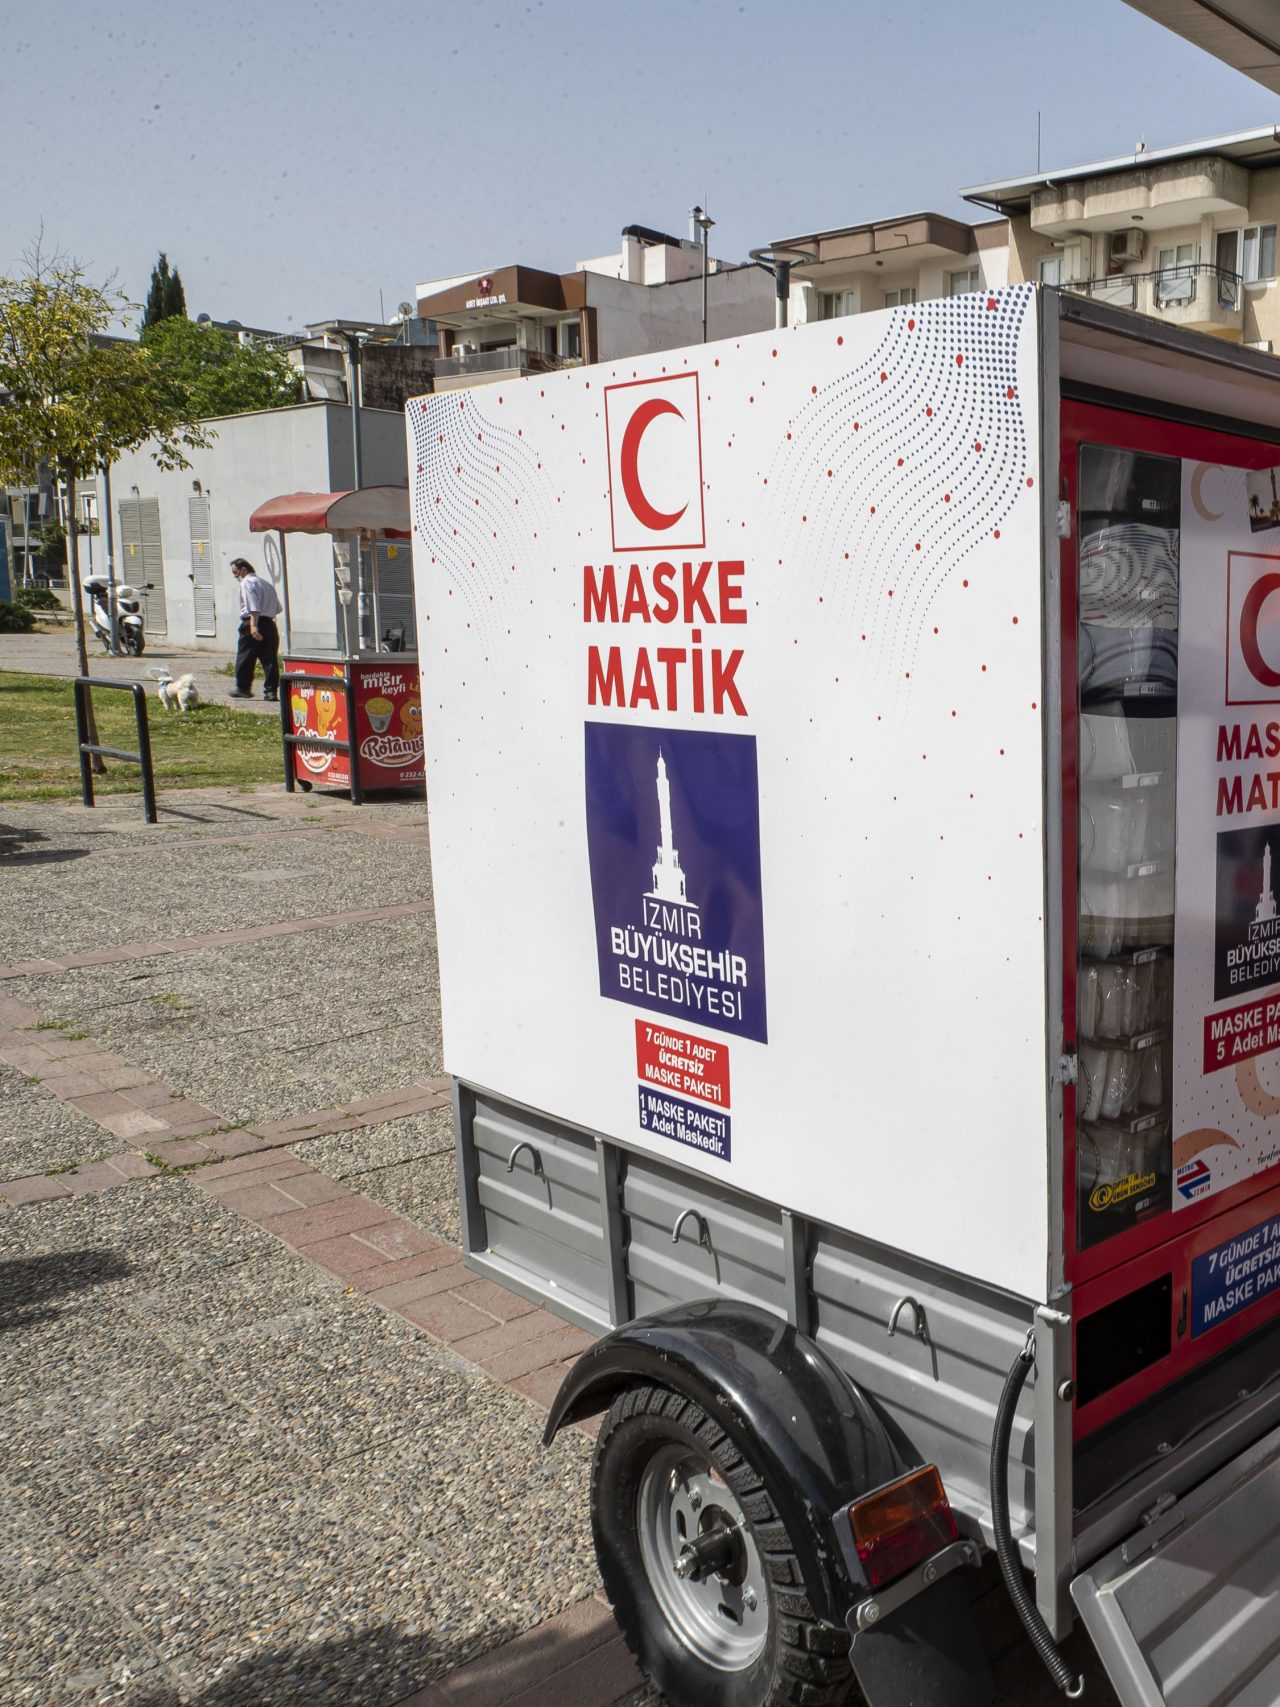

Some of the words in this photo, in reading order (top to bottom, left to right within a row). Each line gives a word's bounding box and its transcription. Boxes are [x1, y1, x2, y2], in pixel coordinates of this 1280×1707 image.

[583, 560, 747, 624] MASKE
[381, 683, 406, 695] keyfi
[588, 629, 748, 716] MATİK
[643, 898, 702, 940] İZMİR
[611, 924, 747, 987] BÜYÜKŞEHİR
[1211, 1007, 1262, 1040] MASKE
[645, 1028, 652, 1042] 7
[654, 1031, 683, 1052] GÜNDE
[685, 1040, 691, 1054] 1
[693, 1046, 716, 1062] ADET
[659, 1049, 704, 1077] ÜCRETSİZ
[1217, 1043, 1225, 1060] 5
[1232, 1032, 1264, 1056] Adet
[645, 1064, 681, 1088] MASKE
[684, 1076, 721, 1102] PAKETİ
[640, 1094, 645, 1108] 1
[648, 1096, 684, 1123] MASKE
[687, 1110, 726, 1137] PAKETİ
[641, 1111, 647, 1125] 5
[652, 1115, 675, 1137] Adet
[677, 1123, 724, 1155] Maskedir.
[1177, 1163, 1194, 1175] METRO
[1209, 1253, 1217, 1274] 7
[1219, 1232, 1259, 1264] GÜNDE
[1262, 1226, 1269, 1244] 1
[1204, 1279, 1252, 1323] MASKE
